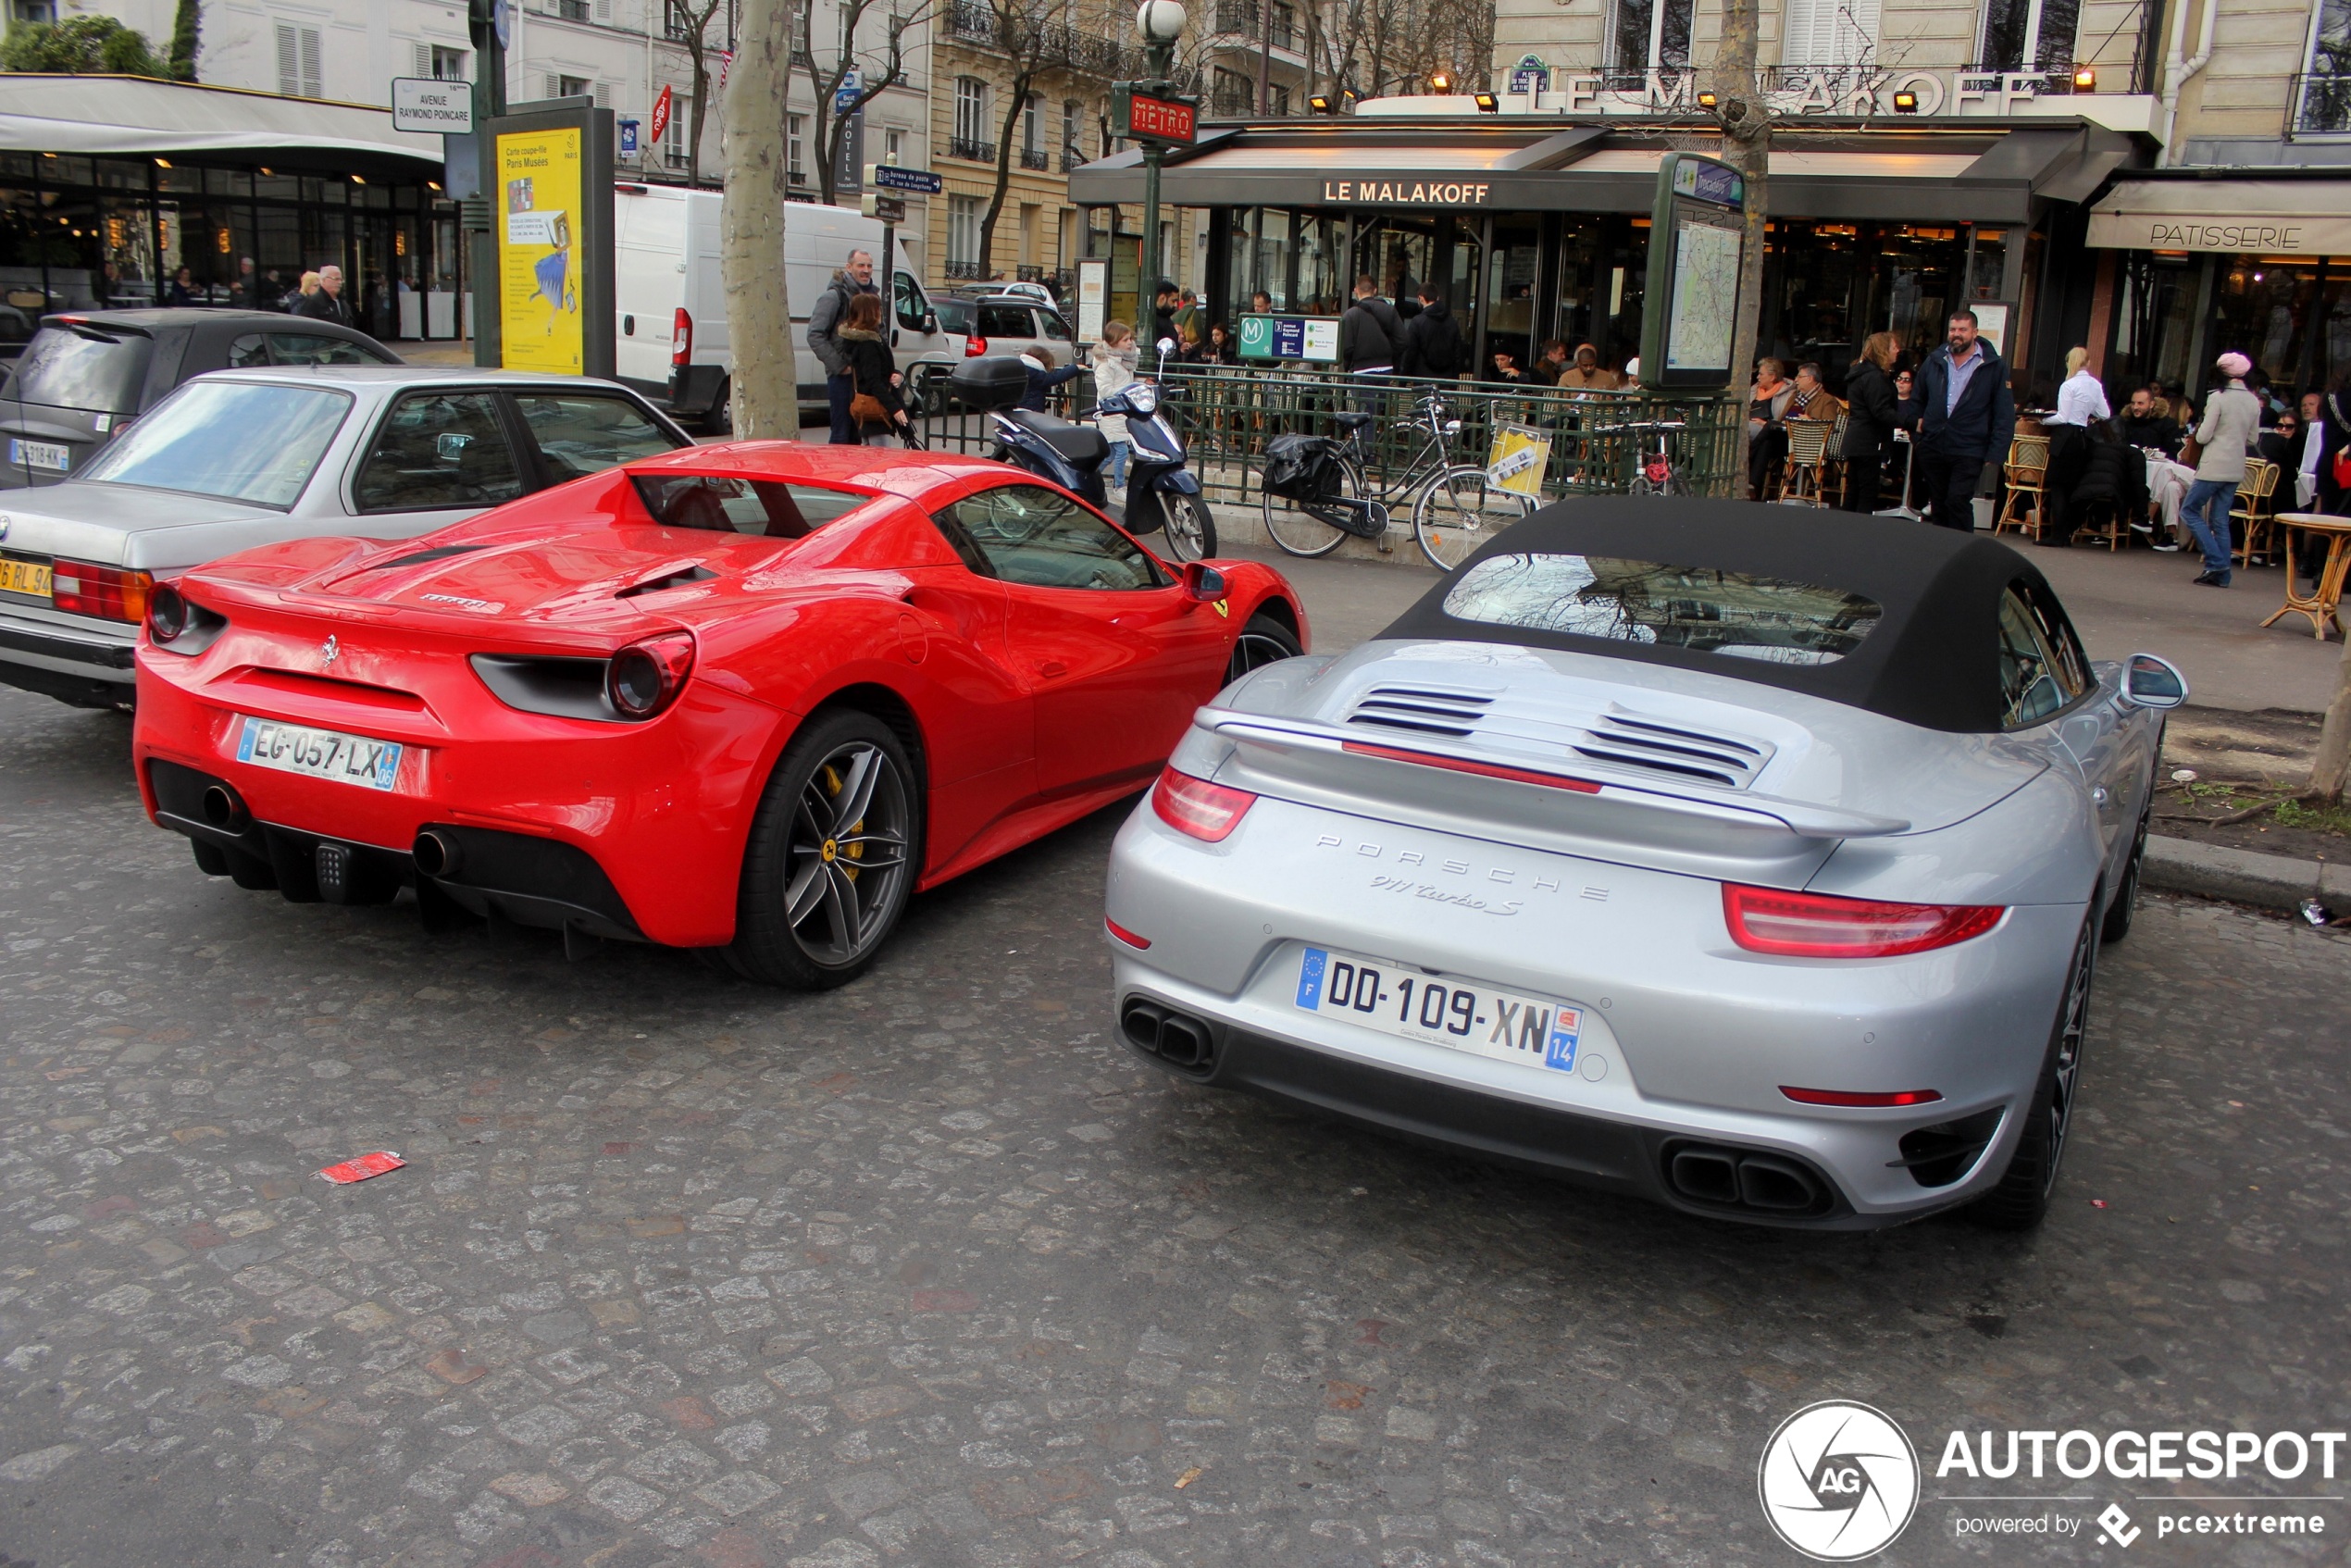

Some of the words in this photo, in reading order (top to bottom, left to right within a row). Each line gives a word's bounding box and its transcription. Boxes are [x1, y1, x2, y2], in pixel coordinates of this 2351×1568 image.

[419, 94, 448, 106] AVENUE
[1524, 74, 1603, 116] LE
[1642, 70, 2047, 118] MLAKOFF
[399, 107, 433, 119] RAYMOND
[433, 110, 468, 121] POINCARE
[653, 96, 667, 131] TABAC
[1135, 102, 1189, 135] METRO
[506, 158, 522, 168] Paris
[523, 156, 549, 168] Musées
[1325, 182, 1351, 201] LE
[1359, 182, 1488, 204] MALAKOFF
[1698, 174, 1725, 194] Trocadéro
[2149, 224, 2303, 249] PATISSERIE
[1245, 322, 1258, 338] M
[378, 768, 392, 785] 06
[1315, 833, 1609, 902] PORSCHE
[1413, 884, 1486, 910] Turbo
[1483, 900, 1524, 916] S
[1304, 983, 1314, 997] F
[1328, 961, 1549, 1054] DD-109-XN
[1552, 1037, 1573, 1063] 14
